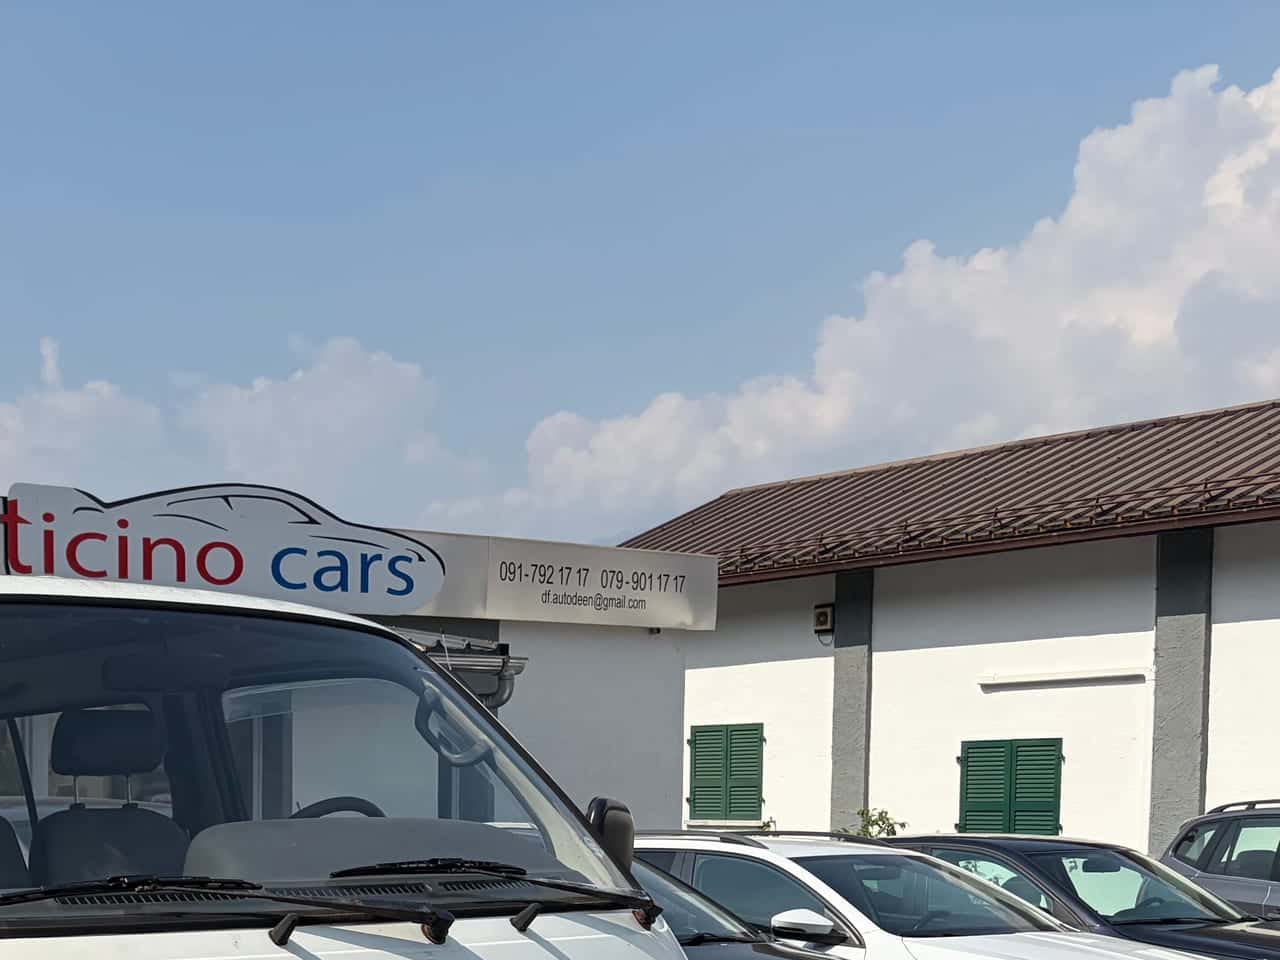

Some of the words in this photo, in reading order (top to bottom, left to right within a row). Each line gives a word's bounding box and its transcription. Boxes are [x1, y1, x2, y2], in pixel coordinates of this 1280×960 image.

[0, 498, 244, 586] ticino
[270, 547, 415, 597] cars
[499, 560, 554, 584] 091-792
[558, 566, 573, 587] 17
[576, 567, 590, 588] 17
[657, 573, 671, 593] 17
[673, 575, 686, 593] 17
[541, 589, 647, 611] df.autodeen@gmail.com
